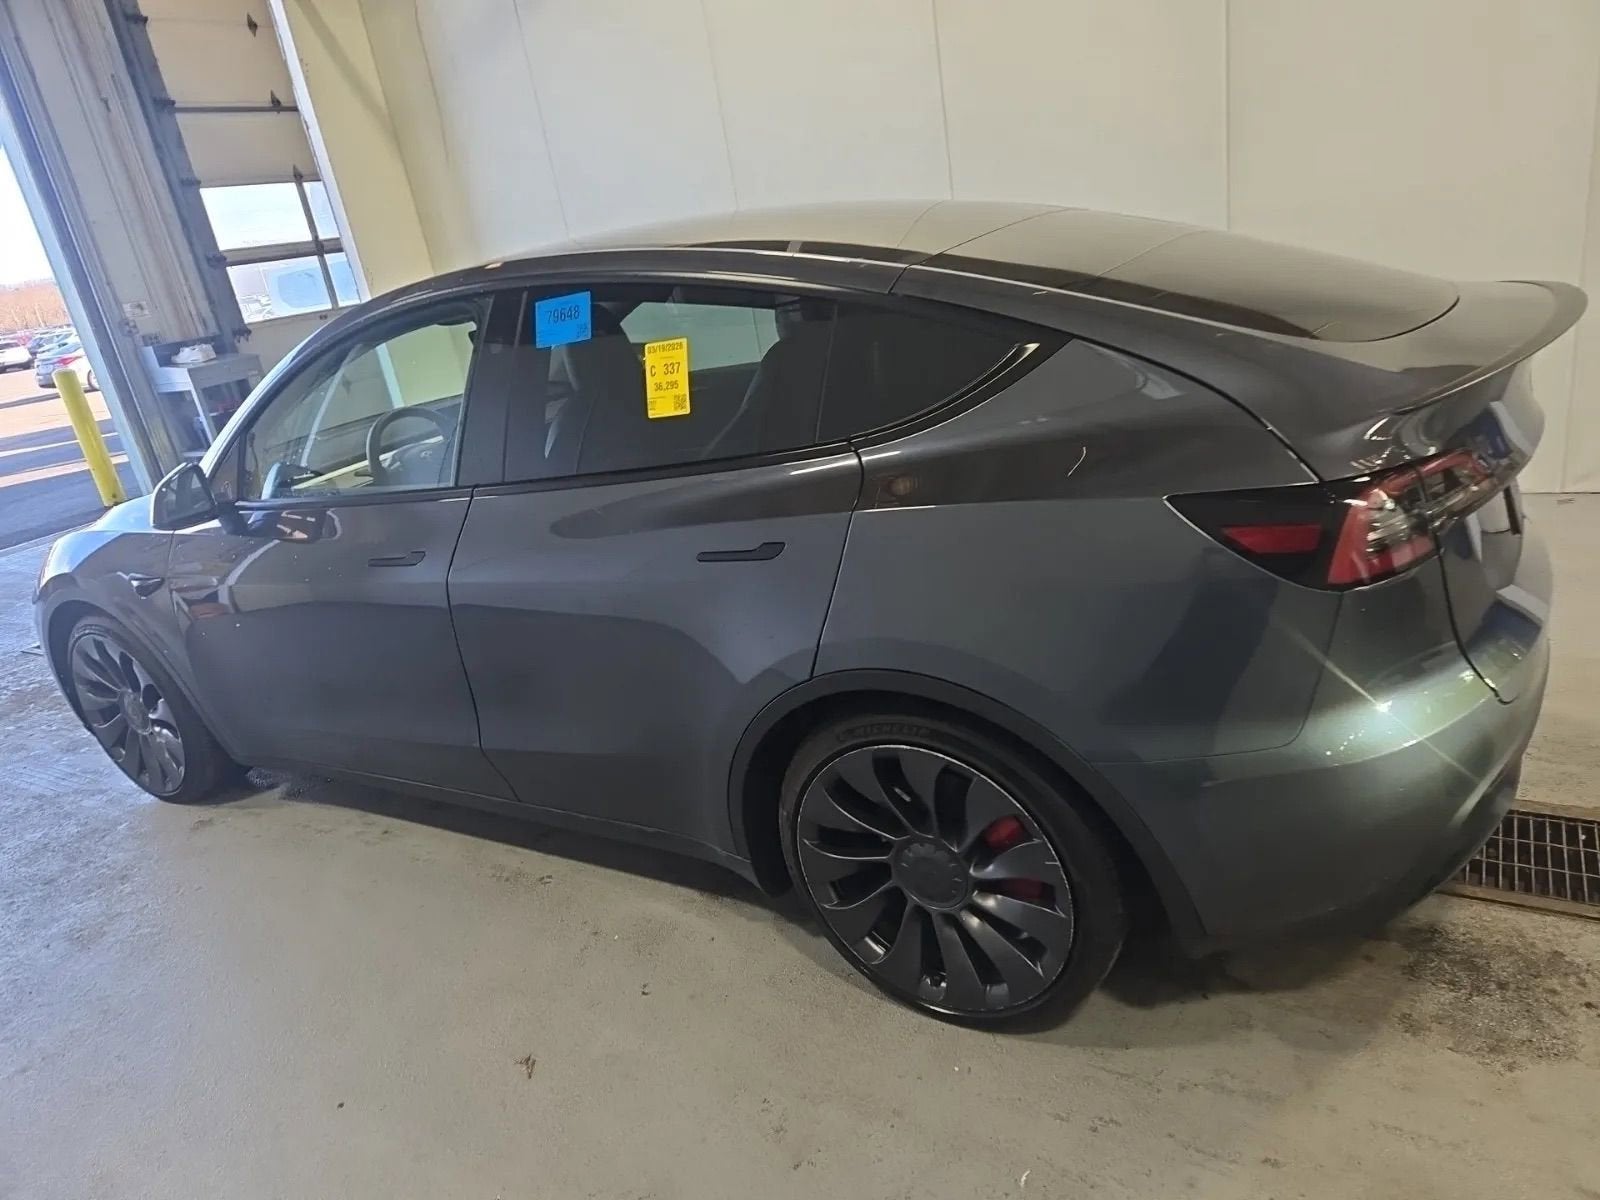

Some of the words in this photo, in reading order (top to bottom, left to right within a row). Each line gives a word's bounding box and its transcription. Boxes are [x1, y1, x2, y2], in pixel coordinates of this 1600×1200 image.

[545, 304, 580, 323] 79648
[650, 365, 656, 377] C
[663, 362, 681, 375] 337
